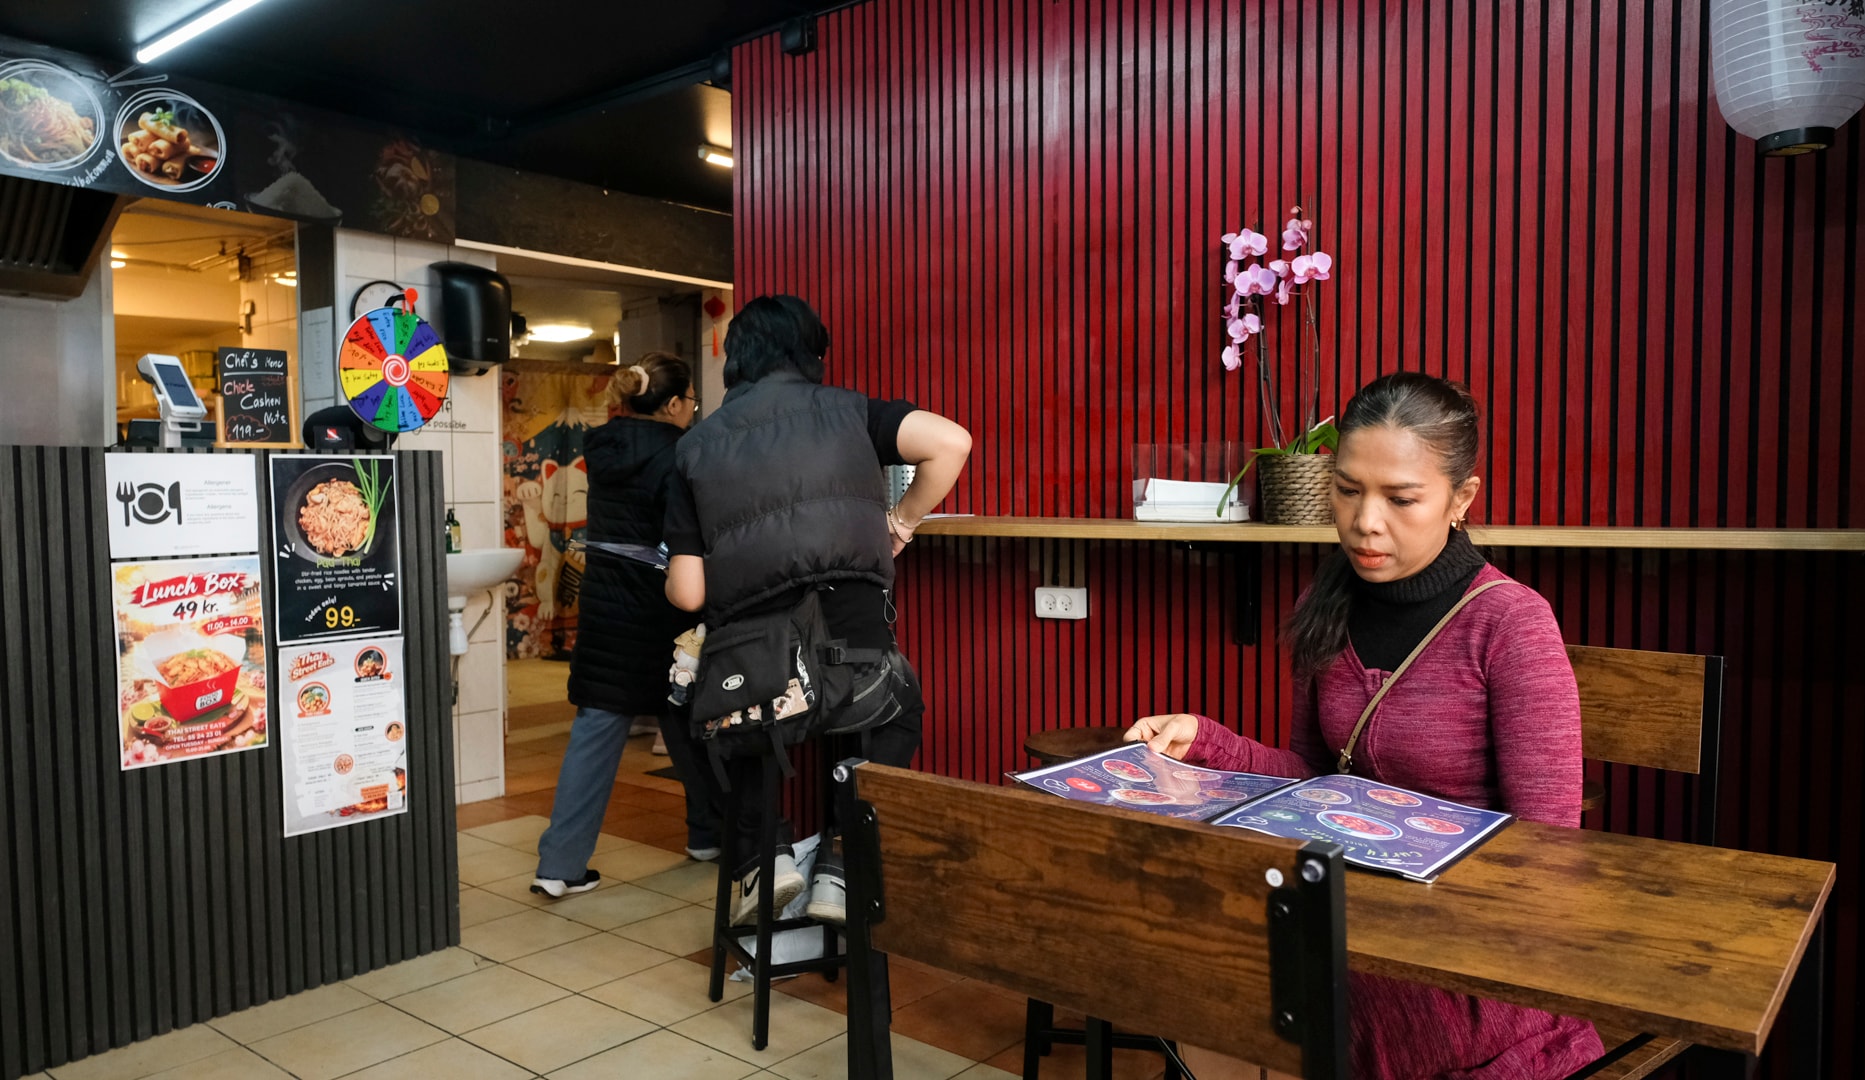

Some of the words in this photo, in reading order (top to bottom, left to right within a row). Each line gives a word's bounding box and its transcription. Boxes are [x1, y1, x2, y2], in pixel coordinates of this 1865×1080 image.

[225, 351, 258, 369] Chef's
[264, 356, 284, 368] Menu
[223, 379, 255, 395] Chick
[433, 420, 467, 429] possible
[317, 558, 335, 568] Pad
[342, 556, 361, 567] Thai
[140, 573, 198, 607] Lunch
[203, 572, 240, 596] Box
[172, 600, 198, 620] 49
[202, 599, 219, 614] kr.
[206, 622, 224, 631] 11.00
[230, 617, 248, 626] 14.00
[299, 651, 324, 666] Thai
[292, 662, 317, 678] Street
[317, 658, 334, 668] Eats
[185, 724, 209, 732] STREET
[1366, 848, 1423, 858] Curry
